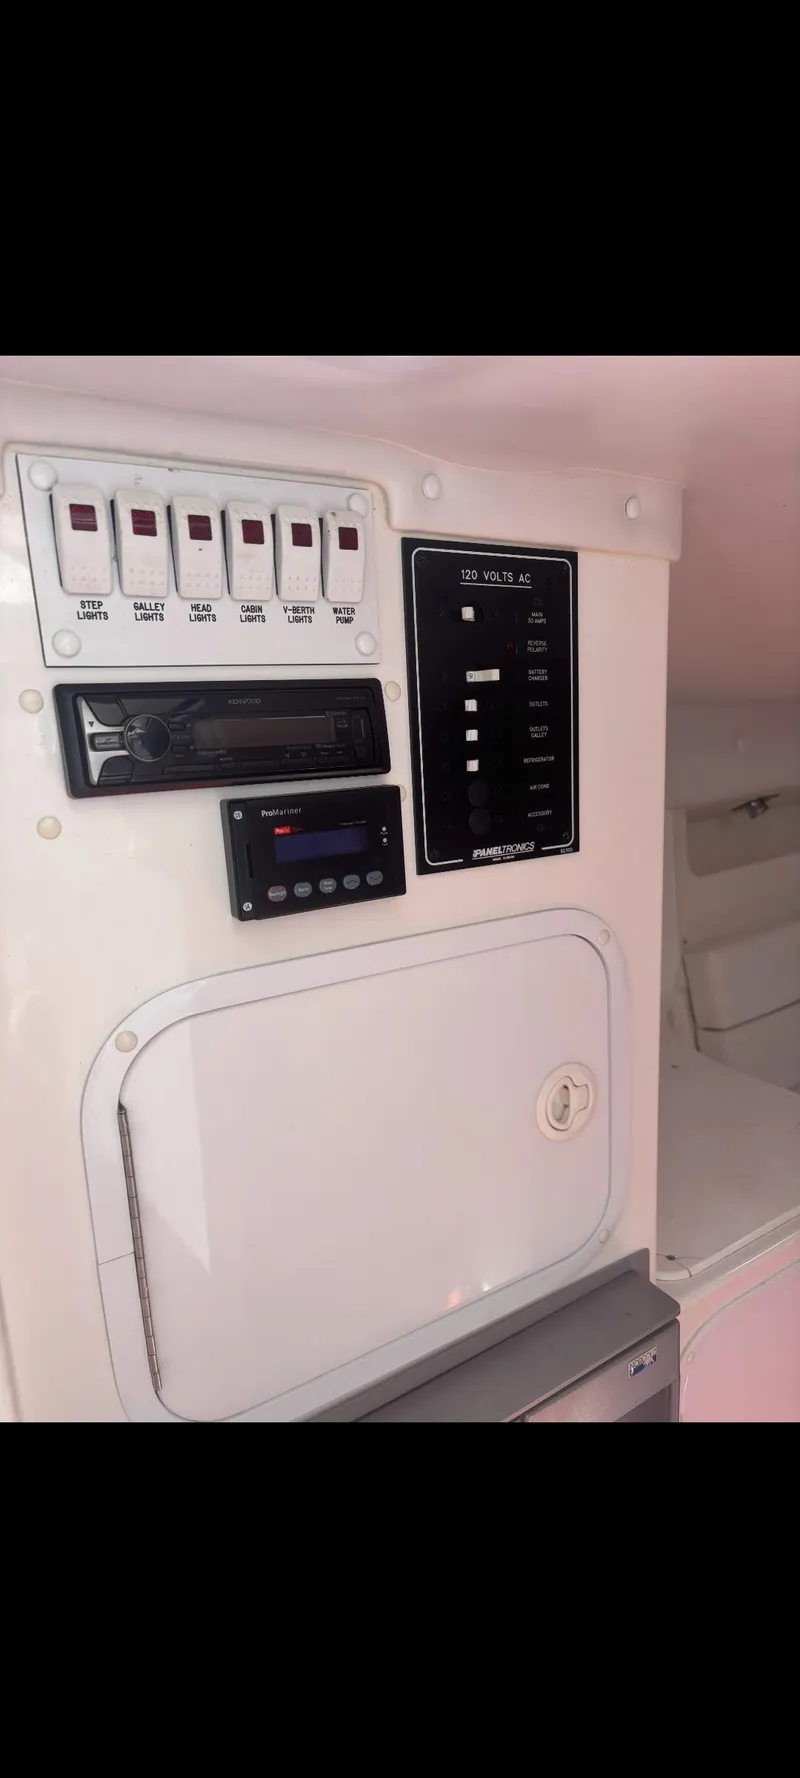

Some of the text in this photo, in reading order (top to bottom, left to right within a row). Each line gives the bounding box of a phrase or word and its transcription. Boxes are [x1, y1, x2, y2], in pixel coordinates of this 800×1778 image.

[461, 570, 530, 583] 120 VOLTS AC
[80, 600, 103, 609] STEP
[133, 602, 165, 611] GALLEY
[191, 604, 212, 612] HEAD
[241, 605, 262, 613] CABIN
[283, 606, 315, 614] V-BERTH
[332, 607, 355, 615] WATER
[77, 611, 108, 620] LIGHTS
[135, 612, 164, 621] LIGHTS
[189, 614, 216, 622] LIGHTS
[240, 614, 266, 623] LIGHTS
[288, 615, 312, 624] LIGHTS
[336, 616, 354, 624] PUMP
[261, 807, 302, 817] ProMariner
